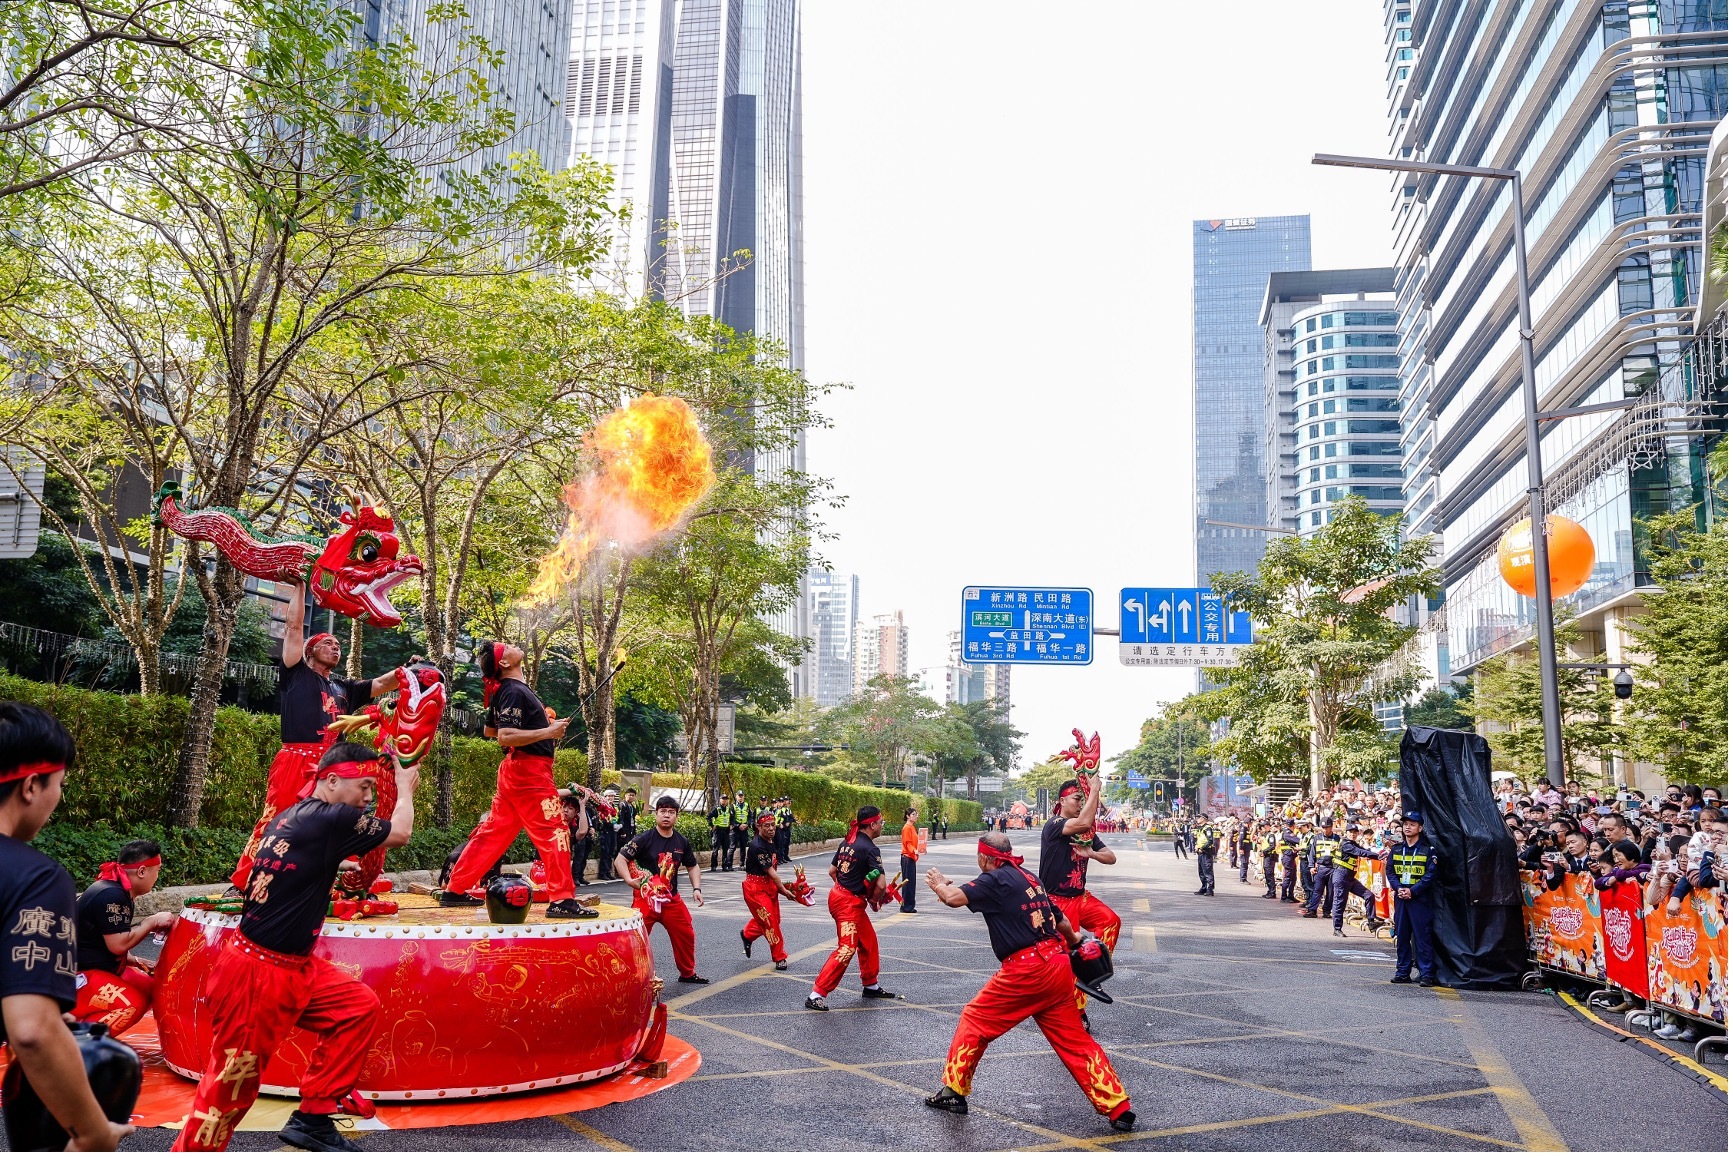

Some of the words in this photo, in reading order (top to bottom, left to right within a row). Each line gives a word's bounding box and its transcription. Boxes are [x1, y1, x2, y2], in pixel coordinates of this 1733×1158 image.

[990, 592, 1028, 603] 新洲路
[1034, 592, 1072, 604] 民田路
[974, 613, 1010, 622] 滨河大道
[1203, 602, 1219, 642] 公交专用
[1010, 631, 1045, 640] 益田路
[968, 641, 1018, 653] 福华三路
[1036, 642, 1087, 654] 福华一路
[505, 885, 530, 907] 酒
